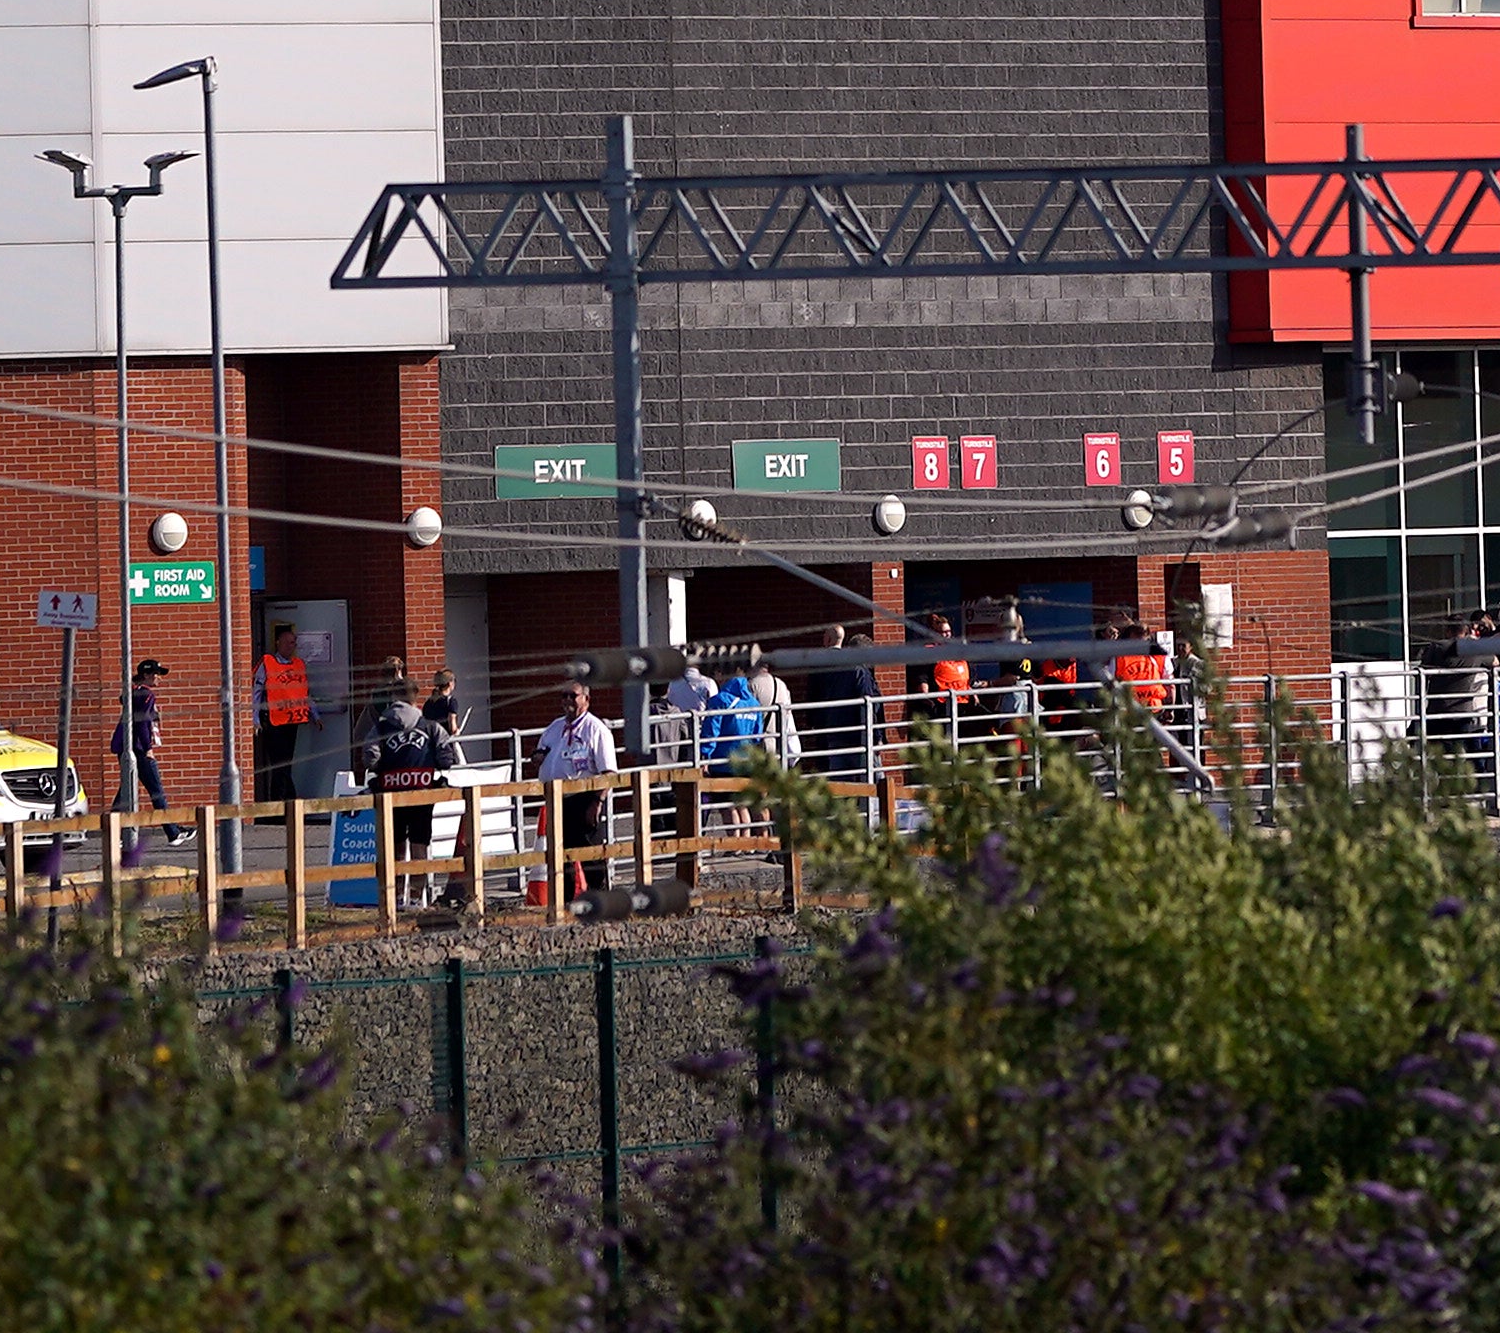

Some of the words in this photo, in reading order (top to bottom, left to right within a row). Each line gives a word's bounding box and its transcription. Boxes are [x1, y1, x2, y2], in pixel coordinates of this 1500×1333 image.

[534, 458, 586, 484] EXIT
[764, 454, 809, 478] EXIT
[924, 452, 939, 482] 8
[971, 452, 986, 481] 7
[1096, 449, 1110, 478] 6
[1169, 447, 1184, 476] 5
[154, 569, 183, 582] FIRST
[185, 568, 206, 582] AID
[154, 584, 191, 597] ROOM
[386, 731, 426, 751] UEFA
[384, 771, 432, 788] PHOTO
[343, 822, 376, 834] South
[342, 837, 376, 849] Coach
[340, 851, 377, 863] Parkin
